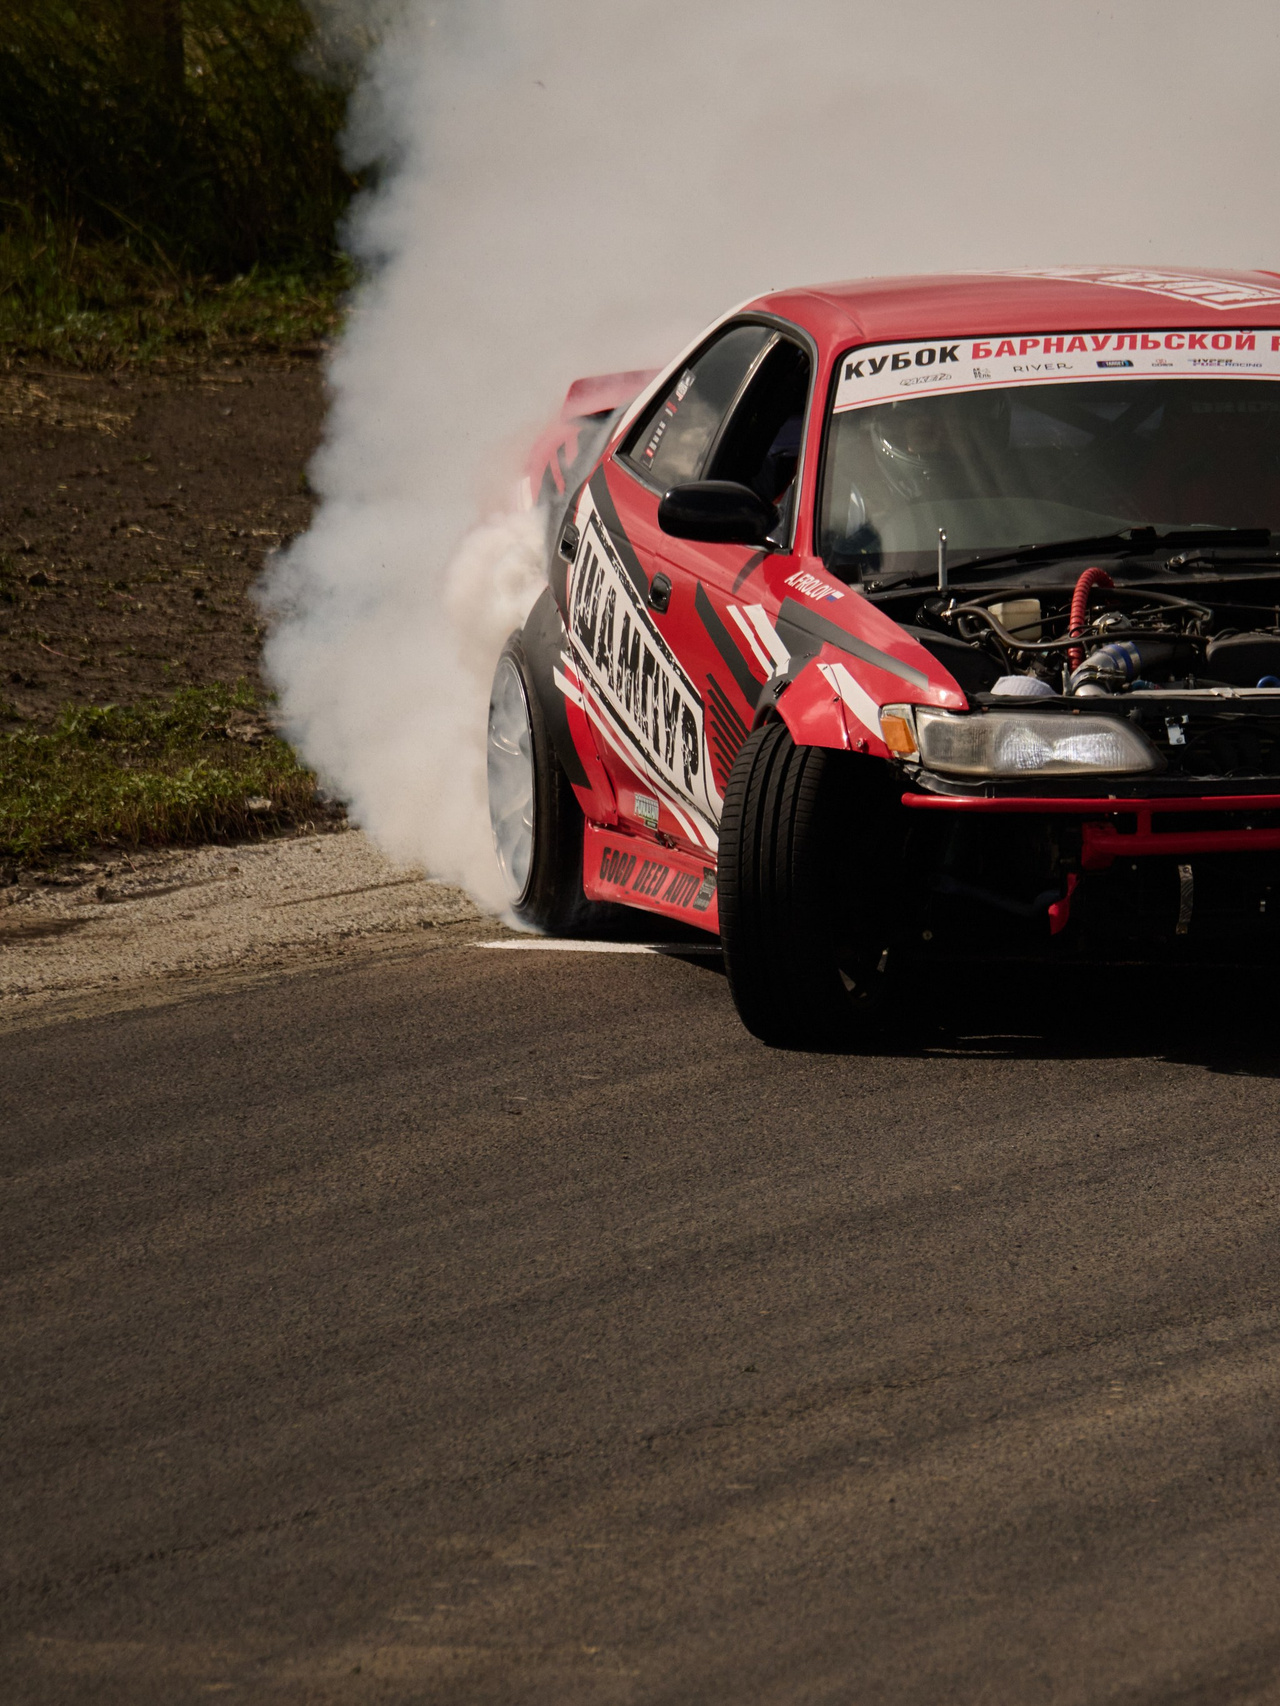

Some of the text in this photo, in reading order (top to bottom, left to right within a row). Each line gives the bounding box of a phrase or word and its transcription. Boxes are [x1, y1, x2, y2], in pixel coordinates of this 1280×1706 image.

[844, 345, 961, 381] КУБОК
[971, 329, 1256, 360] БАРНАУЛЬСКОЙ
[1013, 362, 1073, 372] RIVER
[599, 846, 637, 887] GOOD
[661, 870, 700, 908] AUTO
